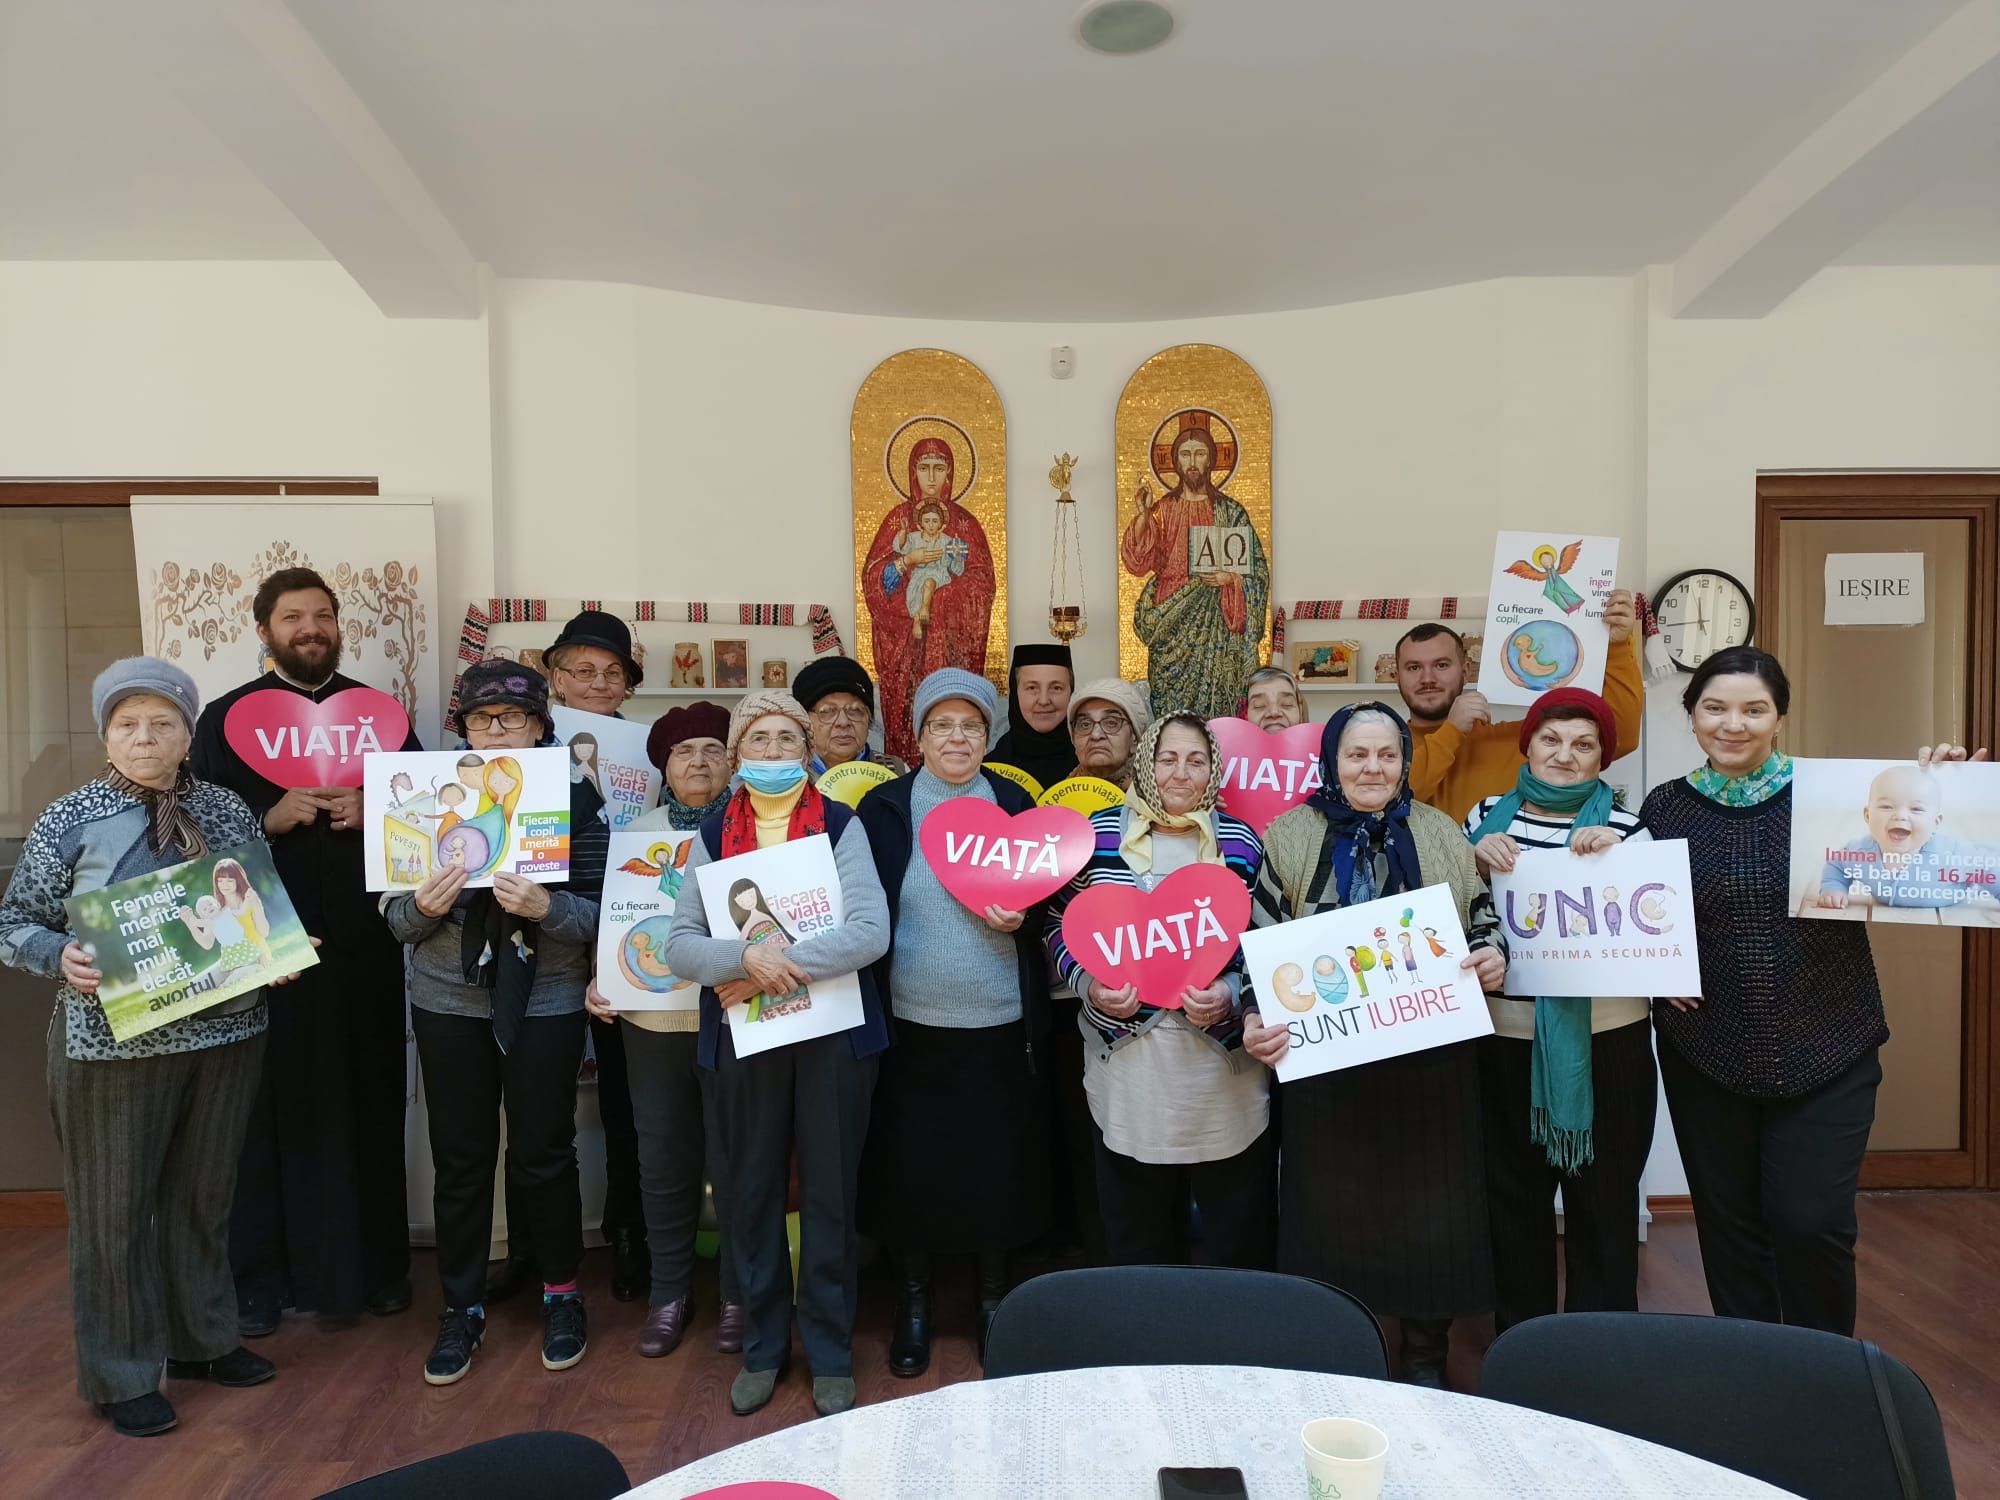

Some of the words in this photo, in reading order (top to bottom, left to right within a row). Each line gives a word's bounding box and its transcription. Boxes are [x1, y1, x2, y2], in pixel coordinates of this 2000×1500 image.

[1678, 584, 1690, 593] 11
[1696, 579, 1710, 588] 12
[1839, 578, 1910, 600] IEȘIRE
[1497, 603, 1510, 613] Cu
[1511, 603, 1544, 615] fiecare
[1664, 598, 1678, 608] 10
[1729, 600, 1737, 610] 2
[1495, 614, 1520, 625] copil,
[1585, 608, 1605, 618] lum
[1658, 616, 1667, 625] 9
[1733, 618, 1742, 627] 3
[1663, 635, 1671, 644] 8
[1675, 649, 1683, 657] 7
[1693, 655, 1702, 664] 6
[254, 715, 384, 764] VIAȚĂ
[824, 767, 857, 790] pentru
[612, 789, 645, 804] este
[1051, 783, 1089, 804] pentru
[622, 803, 642, 816] un
[522, 815, 560, 826] Fiecare
[530, 825, 555, 838] copil
[525, 836, 559, 849] merită
[537, 851, 545, 860] o
[945, 831, 1061, 880] VIAȚĂ
[1825, 847, 1877, 863] Inima
[1882, 852, 1923, 865] mea
[1929, 853, 1939, 865] a
[1944, 850, 2000, 871] încep
[520, 861, 560, 875] poveste
[1843, 864, 1863, 879] să
[1868, 865, 1910, 881] bată
[1915, 866, 1931, 882] la
[1937, 868, 1960, 883] 16
[1965, 869, 1996, 884] zile
[1848, 880, 1872, 896] de
[1877, 881, 1893, 897] la
[110, 882, 187, 918] Femeile
[611, 901, 624, 911] Cu
[626, 901, 660, 911] fiecare
[765, 887, 827, 910] Fiecare
[119, 900, 181, 937] merită
[797, 914, 834, 933] este
[1092, 896, 1229, 966] VIAȚĂ
[126, 928, 165, 956] mai
[1511, 950, 1534, 960] DIN
[1542, 949, 1592, 960] PRIMA
[1602, 944, 1683, 959] SECUNDĂ
[133, 946, 181, 975] mult
[142, 961, 196, 993] decât
[148, 972, 217, 1012] avortul
[1287, 1005, 1361, 1049] SUNT
[1367, 983, 1461, 1030] IUBIRE
